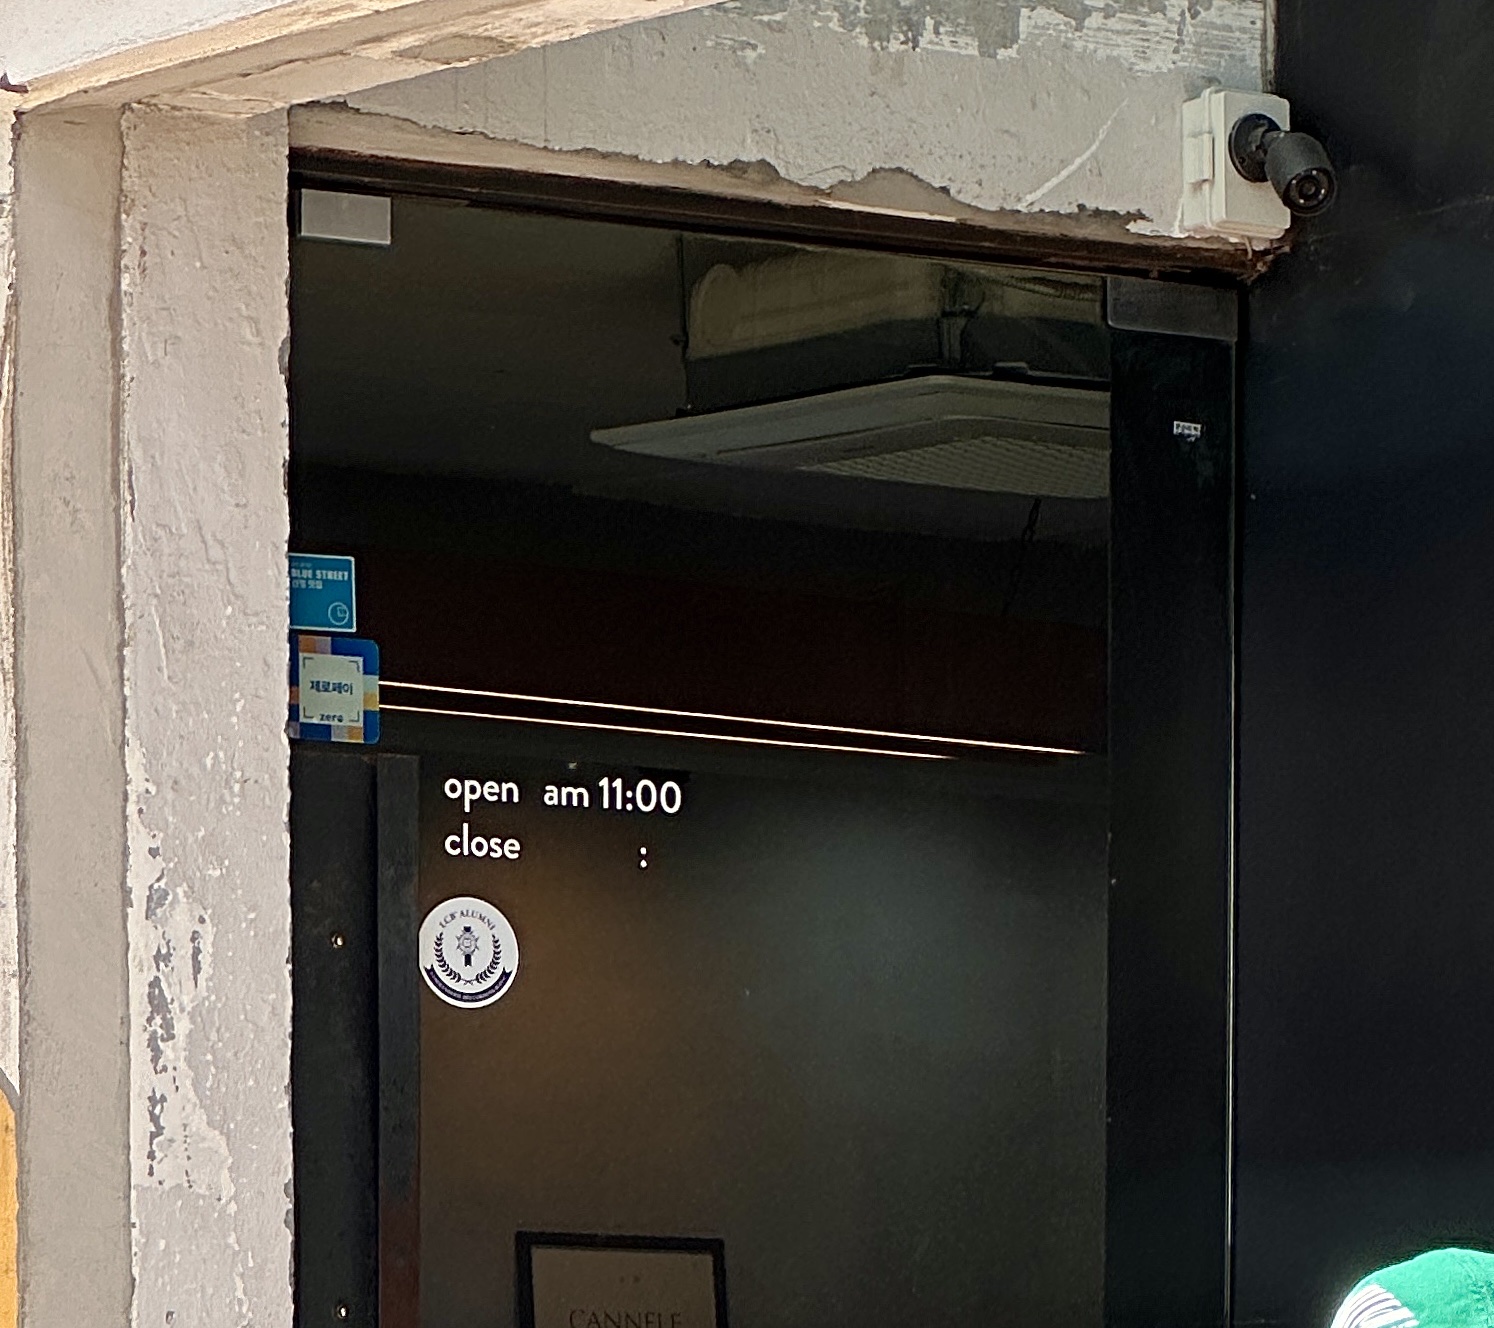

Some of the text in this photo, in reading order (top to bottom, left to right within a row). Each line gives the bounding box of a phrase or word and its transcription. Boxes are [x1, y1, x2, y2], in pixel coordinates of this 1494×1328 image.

[316, 570, 349, 581] STREET
[309, 680, 354, 696] 제로페이
[444, 776, 682, 814] open am 11:00
[444, 822, 521, 859] close
[460, 909, 496, 931] ALUMNI
